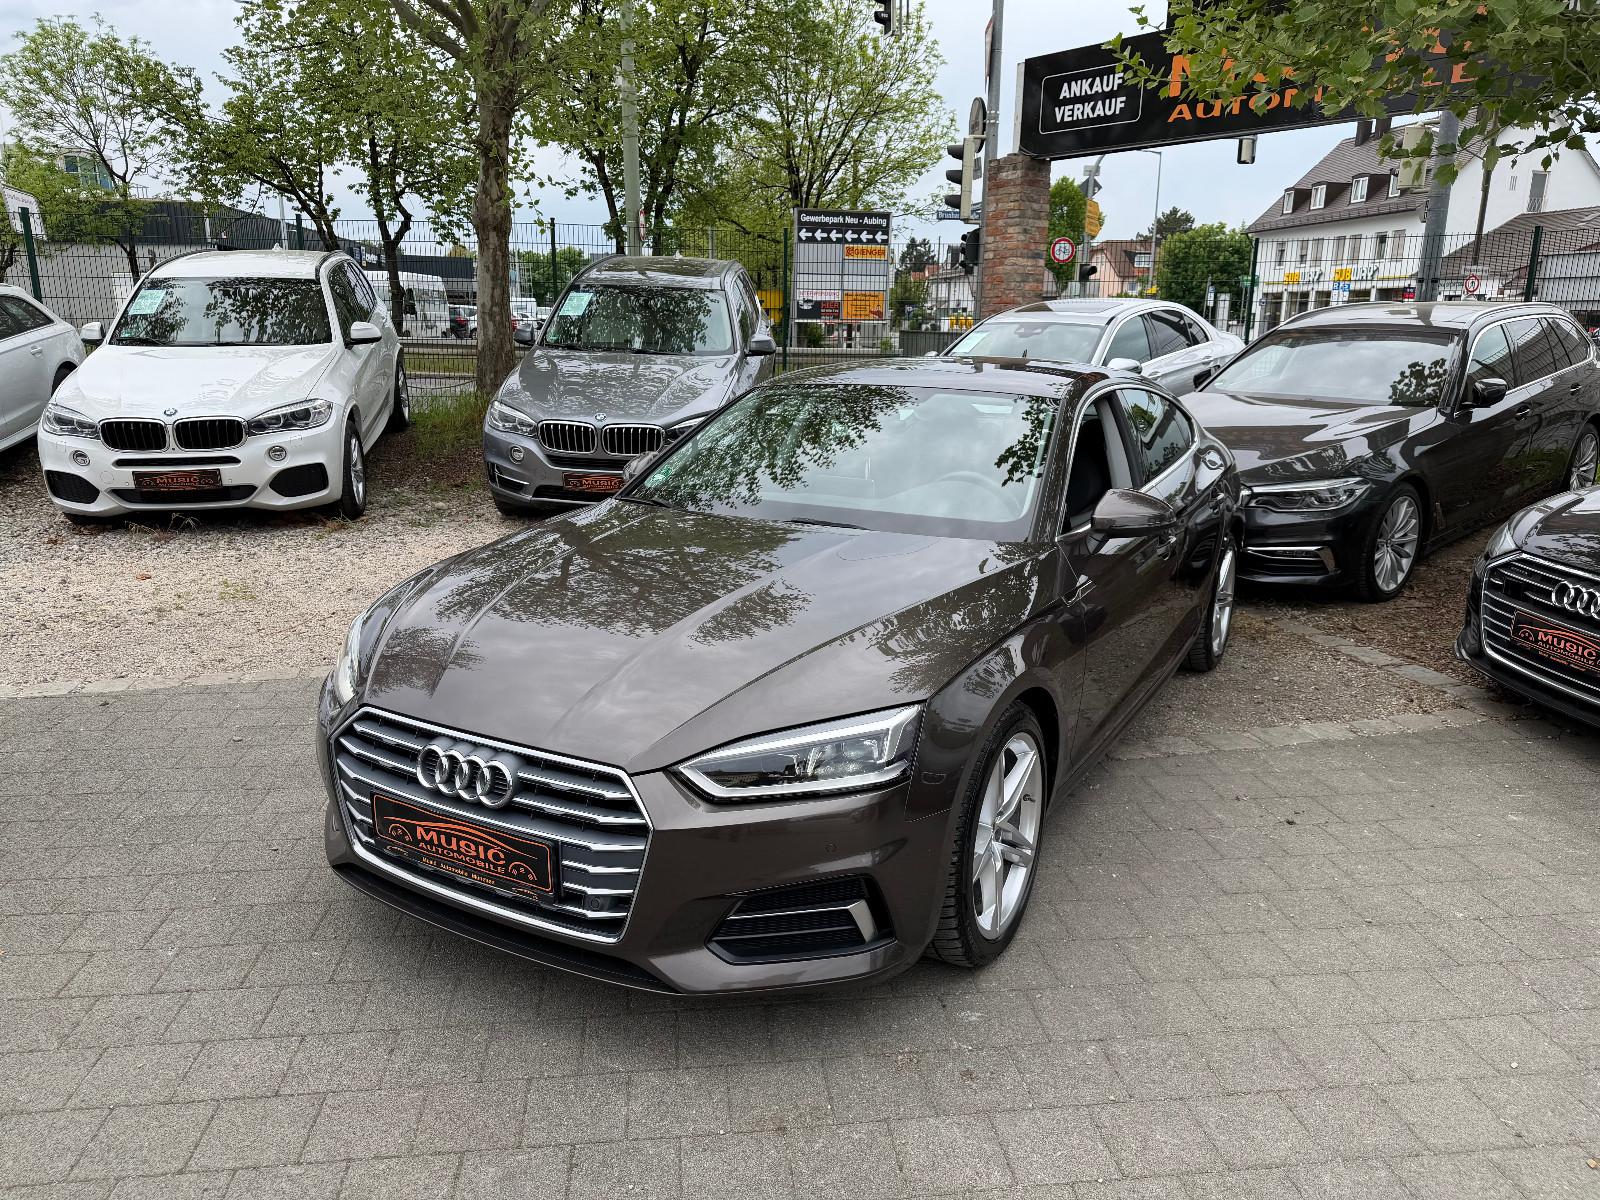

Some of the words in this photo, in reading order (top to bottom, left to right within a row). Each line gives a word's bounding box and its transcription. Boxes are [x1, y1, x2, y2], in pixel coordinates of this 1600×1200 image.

[1059, 72, 1125, 100] ANKAUF
[1054, 96, 1127, 123] VERKAUF
[800, 213, 844, 225] Gewerbepark
[845, 215, 859, 224] Neu
[863, 216, 887, 227] Aubing
[855, 248, 886, 257] GIENGER
[1333, 264, 1379, 281] SUBWAY
[1538, 631, 1598, 661] MUSIC
[416, 825, 506, 865] MUSIC
[419, 842, 505, 874] AUTOMOBILE
